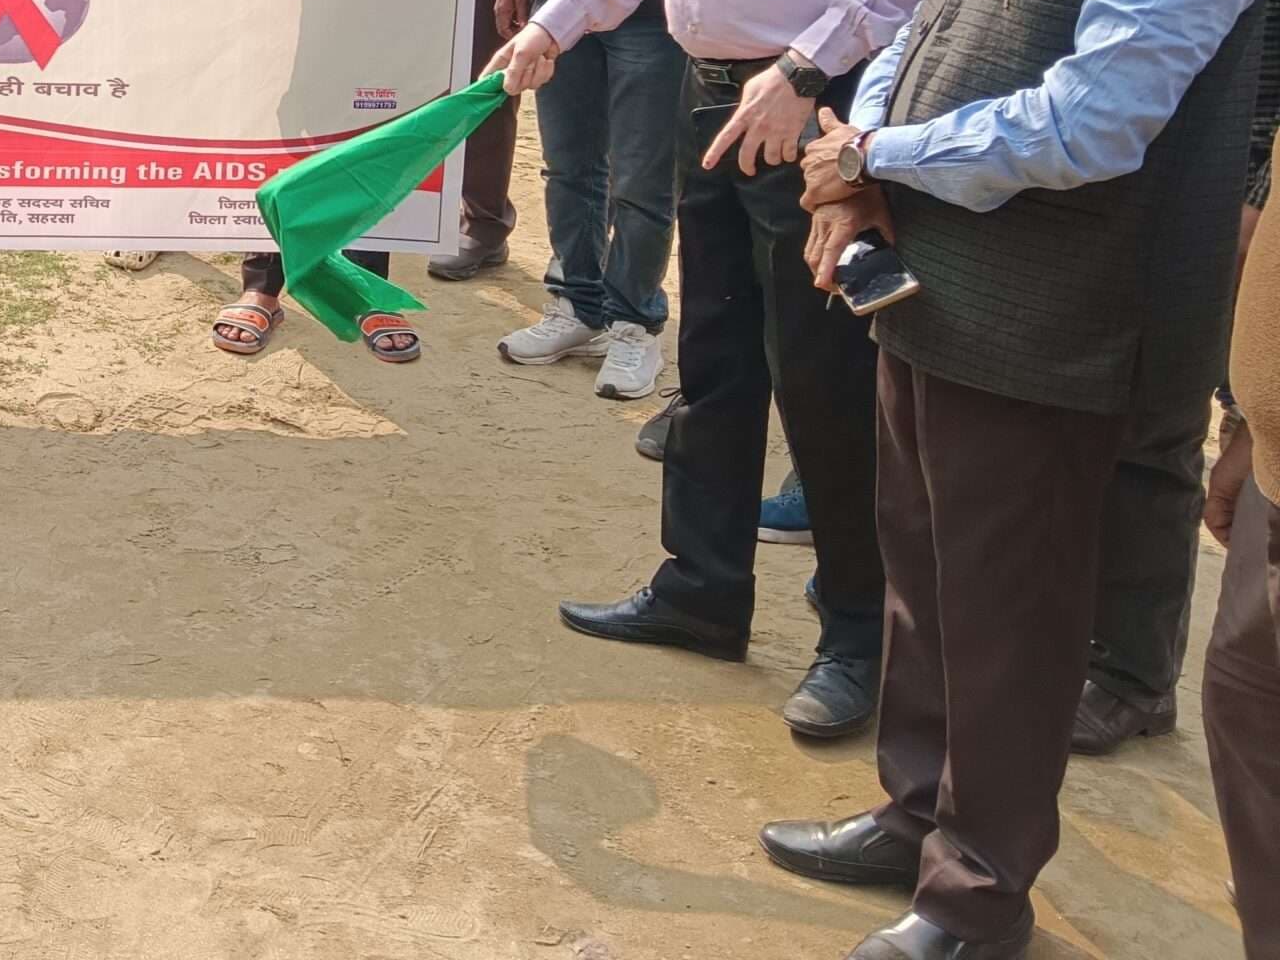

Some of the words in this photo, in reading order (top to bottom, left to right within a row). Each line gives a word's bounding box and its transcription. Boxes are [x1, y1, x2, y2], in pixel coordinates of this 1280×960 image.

[33, 81, 101, 97] बचाव
[107, 77, 130, 99] है
[136, 161, 183, 181] the
[192, 162, 266, 181] AIDS
[17, 198, 64, 209] सदस्य
[69, 196, 111, 209] सचिव
[218, 196, 257, 210] जिला
[28, 213, 75, 224] सहरसा
[188, 211, 227, 225] जिला
